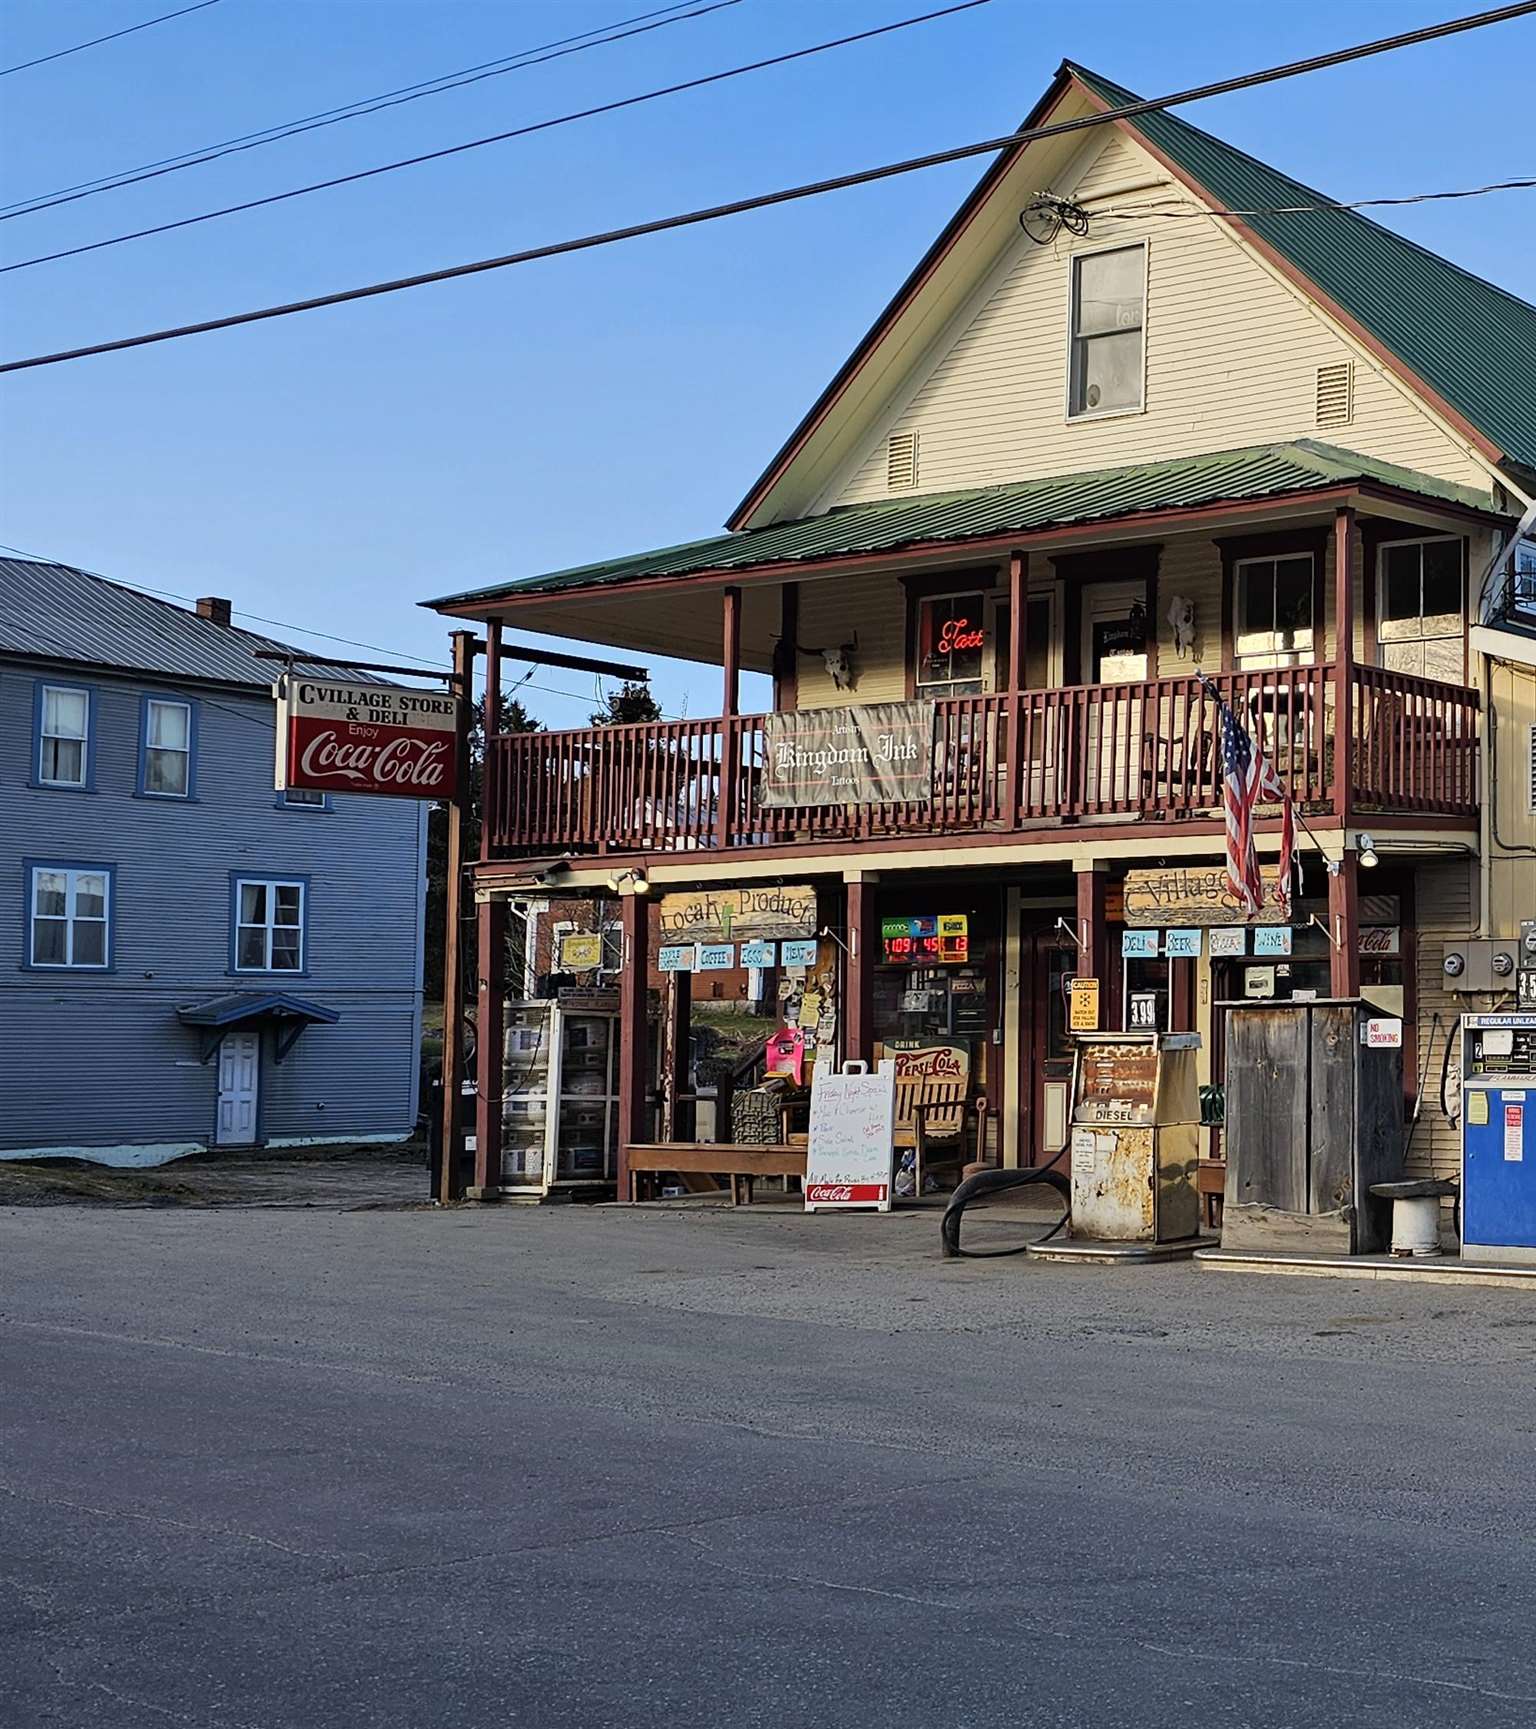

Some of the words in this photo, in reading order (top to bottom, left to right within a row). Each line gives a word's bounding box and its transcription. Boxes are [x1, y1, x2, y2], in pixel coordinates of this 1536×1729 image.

[318, 688, 392, 708] VILLAGE
[399, 696, 454, 715] STORE
[346, 707, 360, 721] &
[368, 709, 408, 725] DELI
[349, 723, 379, 739] Enjoy
[301, 731, 449, 786] Coca-Cola
[774, 740, 868, 778] Kingdom
[873, 734, 918, 769] Ink
[1124, 935, 1145, 952] DELI
[1167, 933, 1193, 953] BEER
[1131, 1000, 1153, 1025] 3.99
[1370, 1023, 1379, 1032] NO
[1481, 1017, 1512, 1026] REGULAR
[895, 1040, 920, 1049] DRINK
[1370, 1033, 1399, 1043] SMOKING
[1095, 1110, 1133, 1121] DIESEL
[810, 1186, 854, 1200] Coca-Cola
